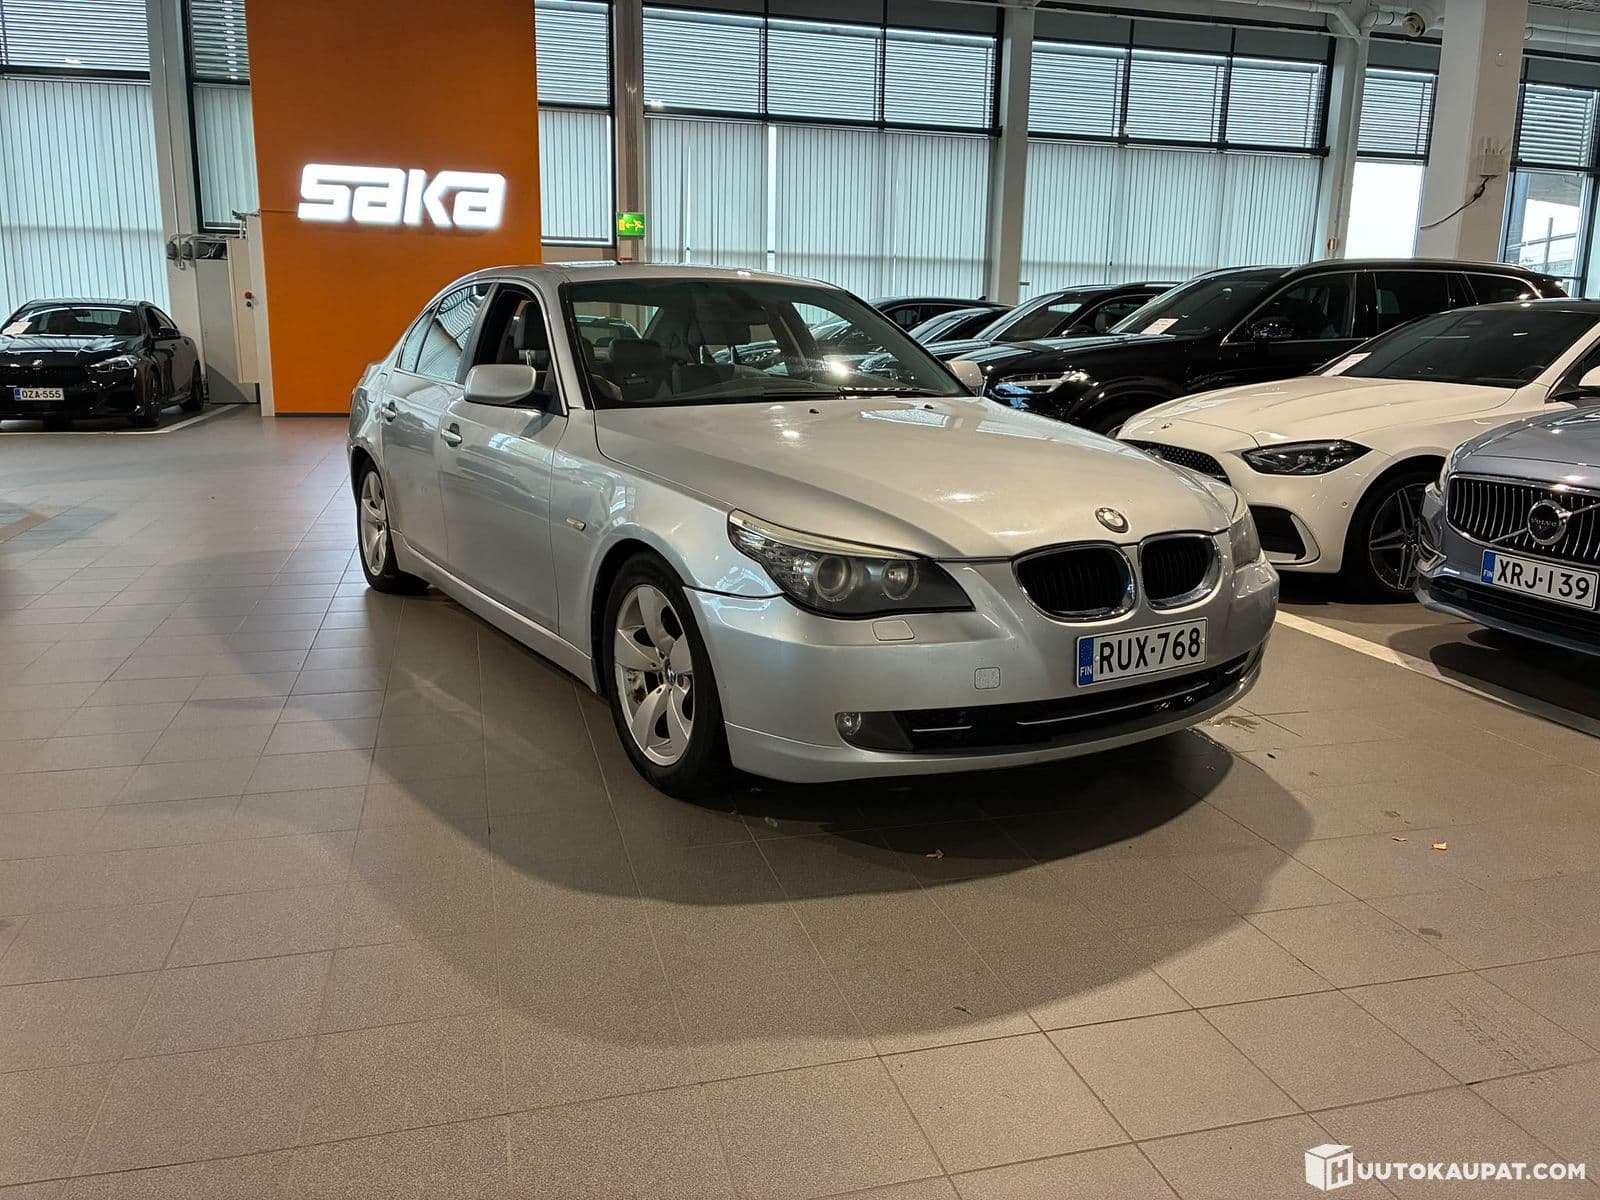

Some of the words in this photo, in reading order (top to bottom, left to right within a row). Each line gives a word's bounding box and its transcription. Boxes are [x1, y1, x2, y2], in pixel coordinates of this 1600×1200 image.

[1497, 559, 1590, 600] XRJ-139
[1080, 665, 1092, 677] FIN
[1100, 627, 1201, 674] RUX-768
